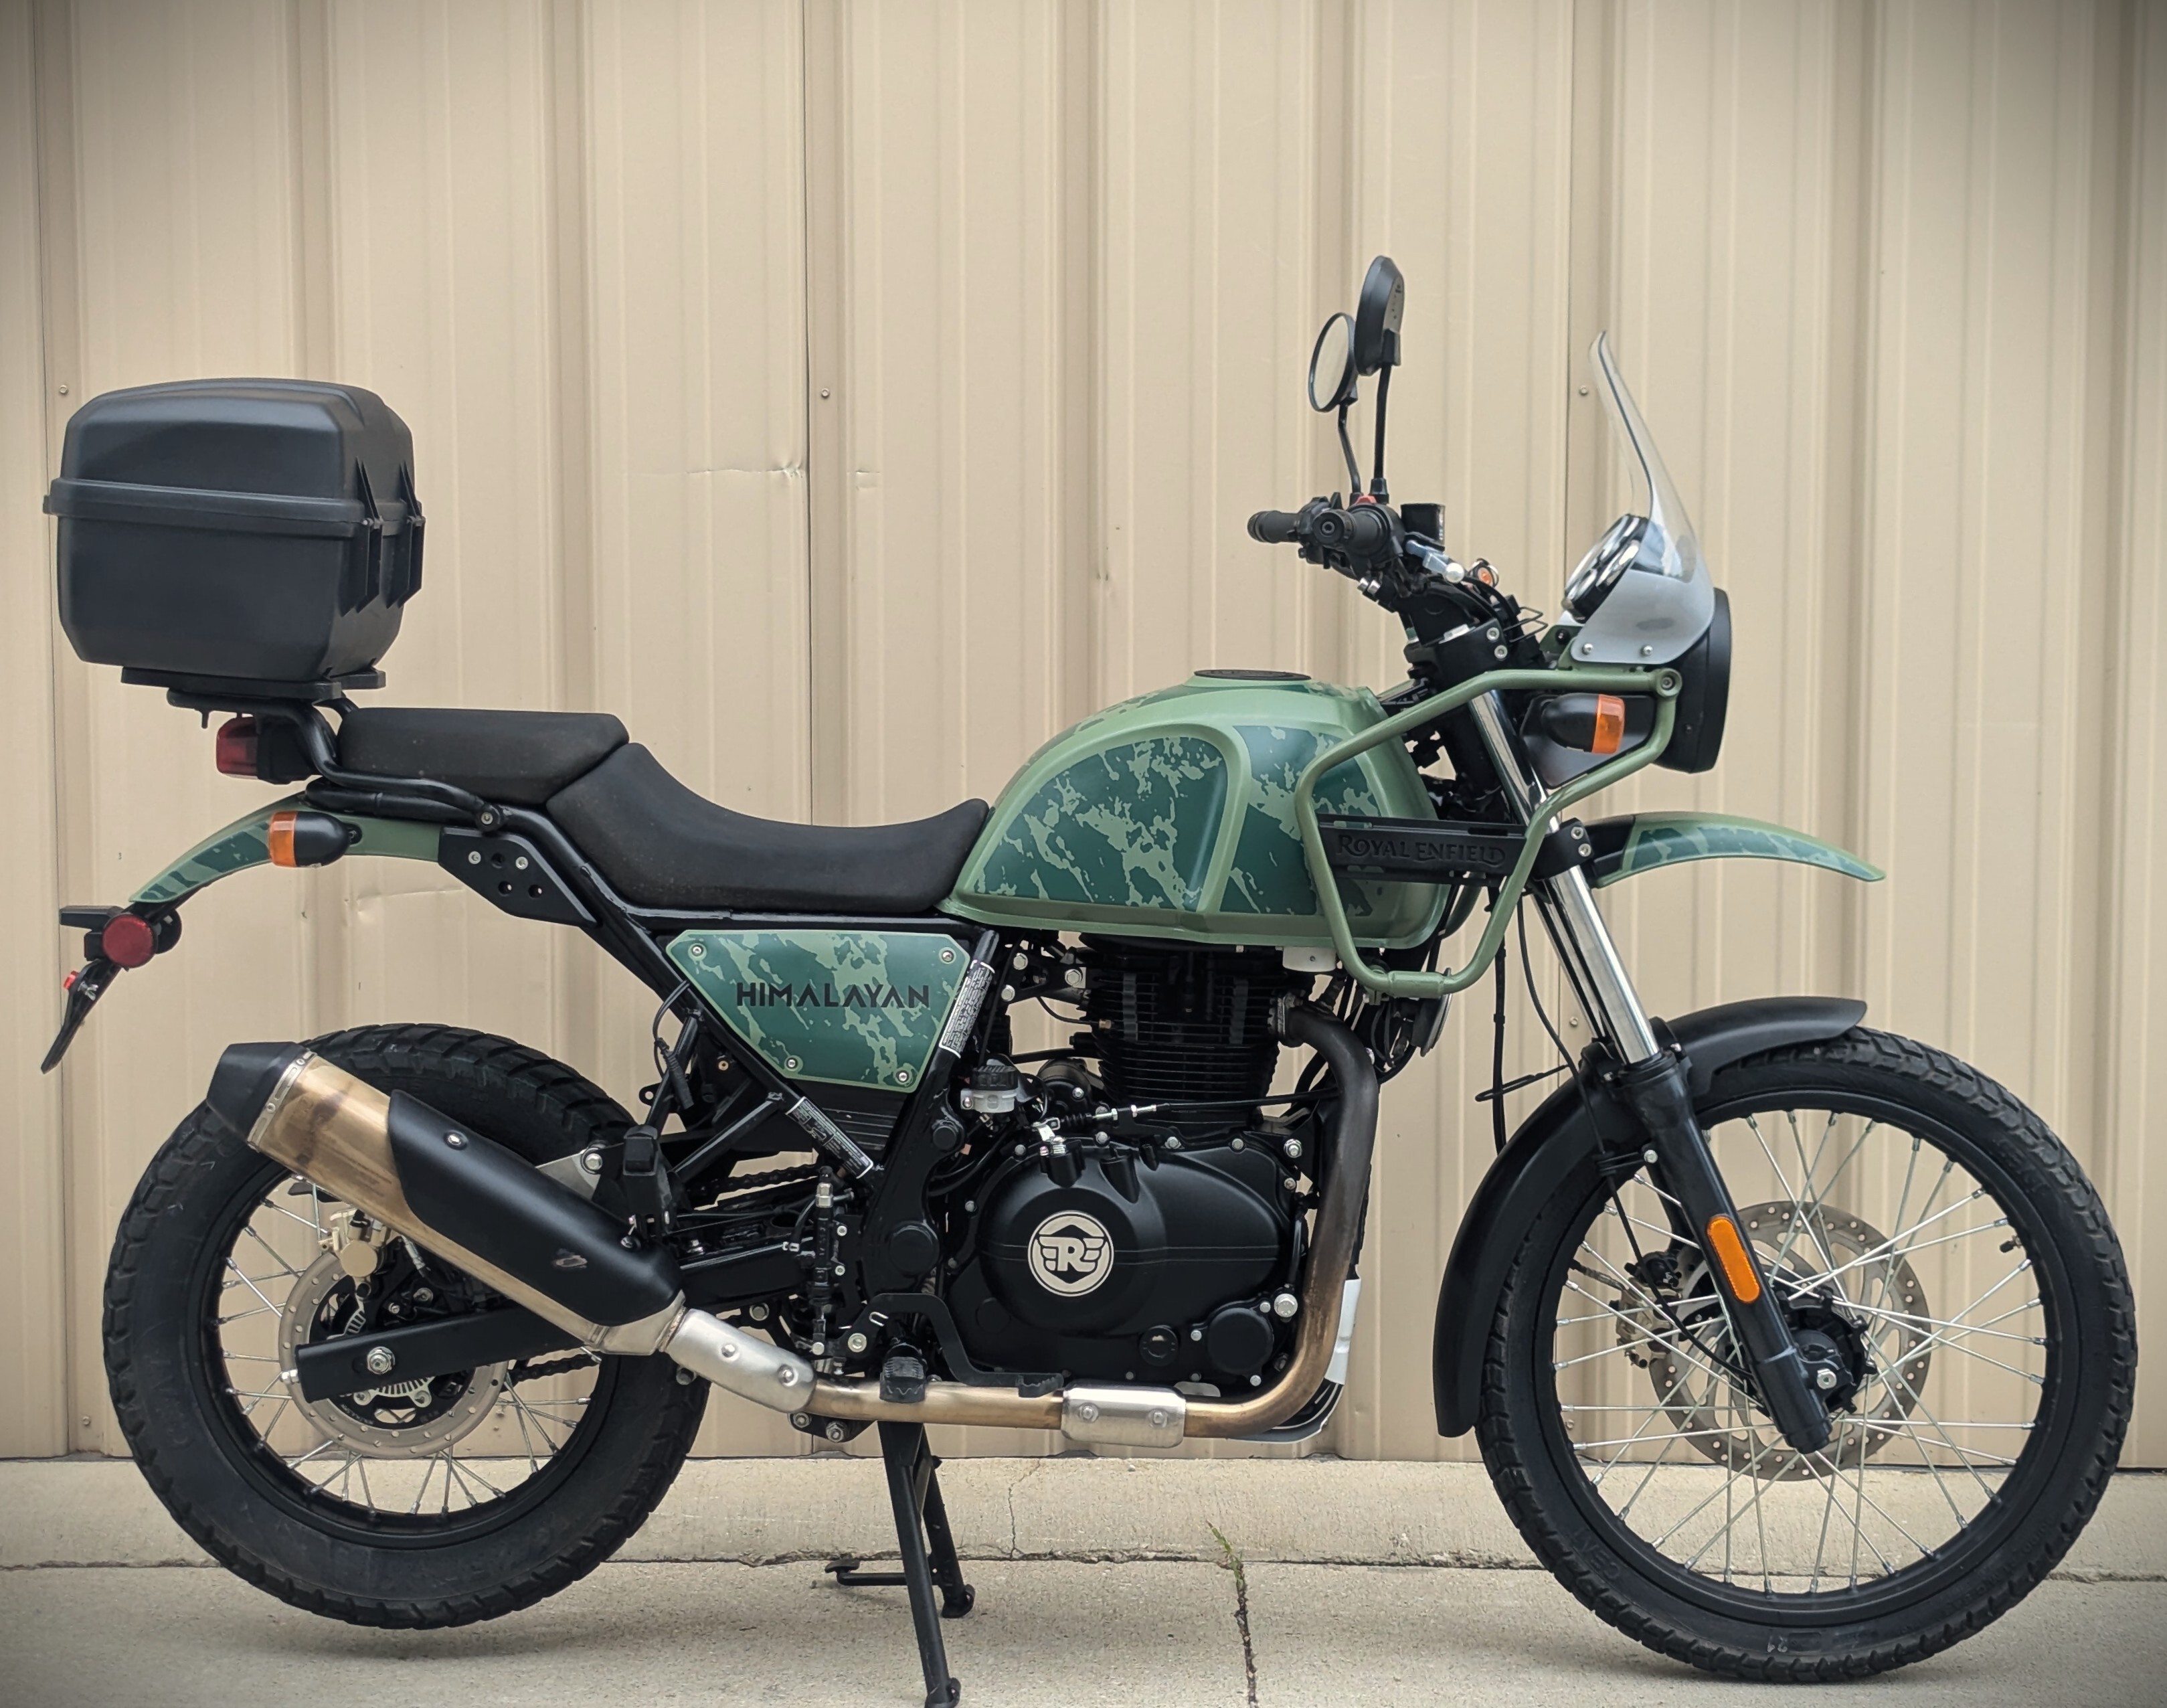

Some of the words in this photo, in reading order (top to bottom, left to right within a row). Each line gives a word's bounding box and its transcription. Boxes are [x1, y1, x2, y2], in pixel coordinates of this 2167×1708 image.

[1337, 834, 1411, 857] ROYAL
[1415, 841, 1506, 867] ENFIELD
[737, 982, 929, 1008] HIMALAYAN
